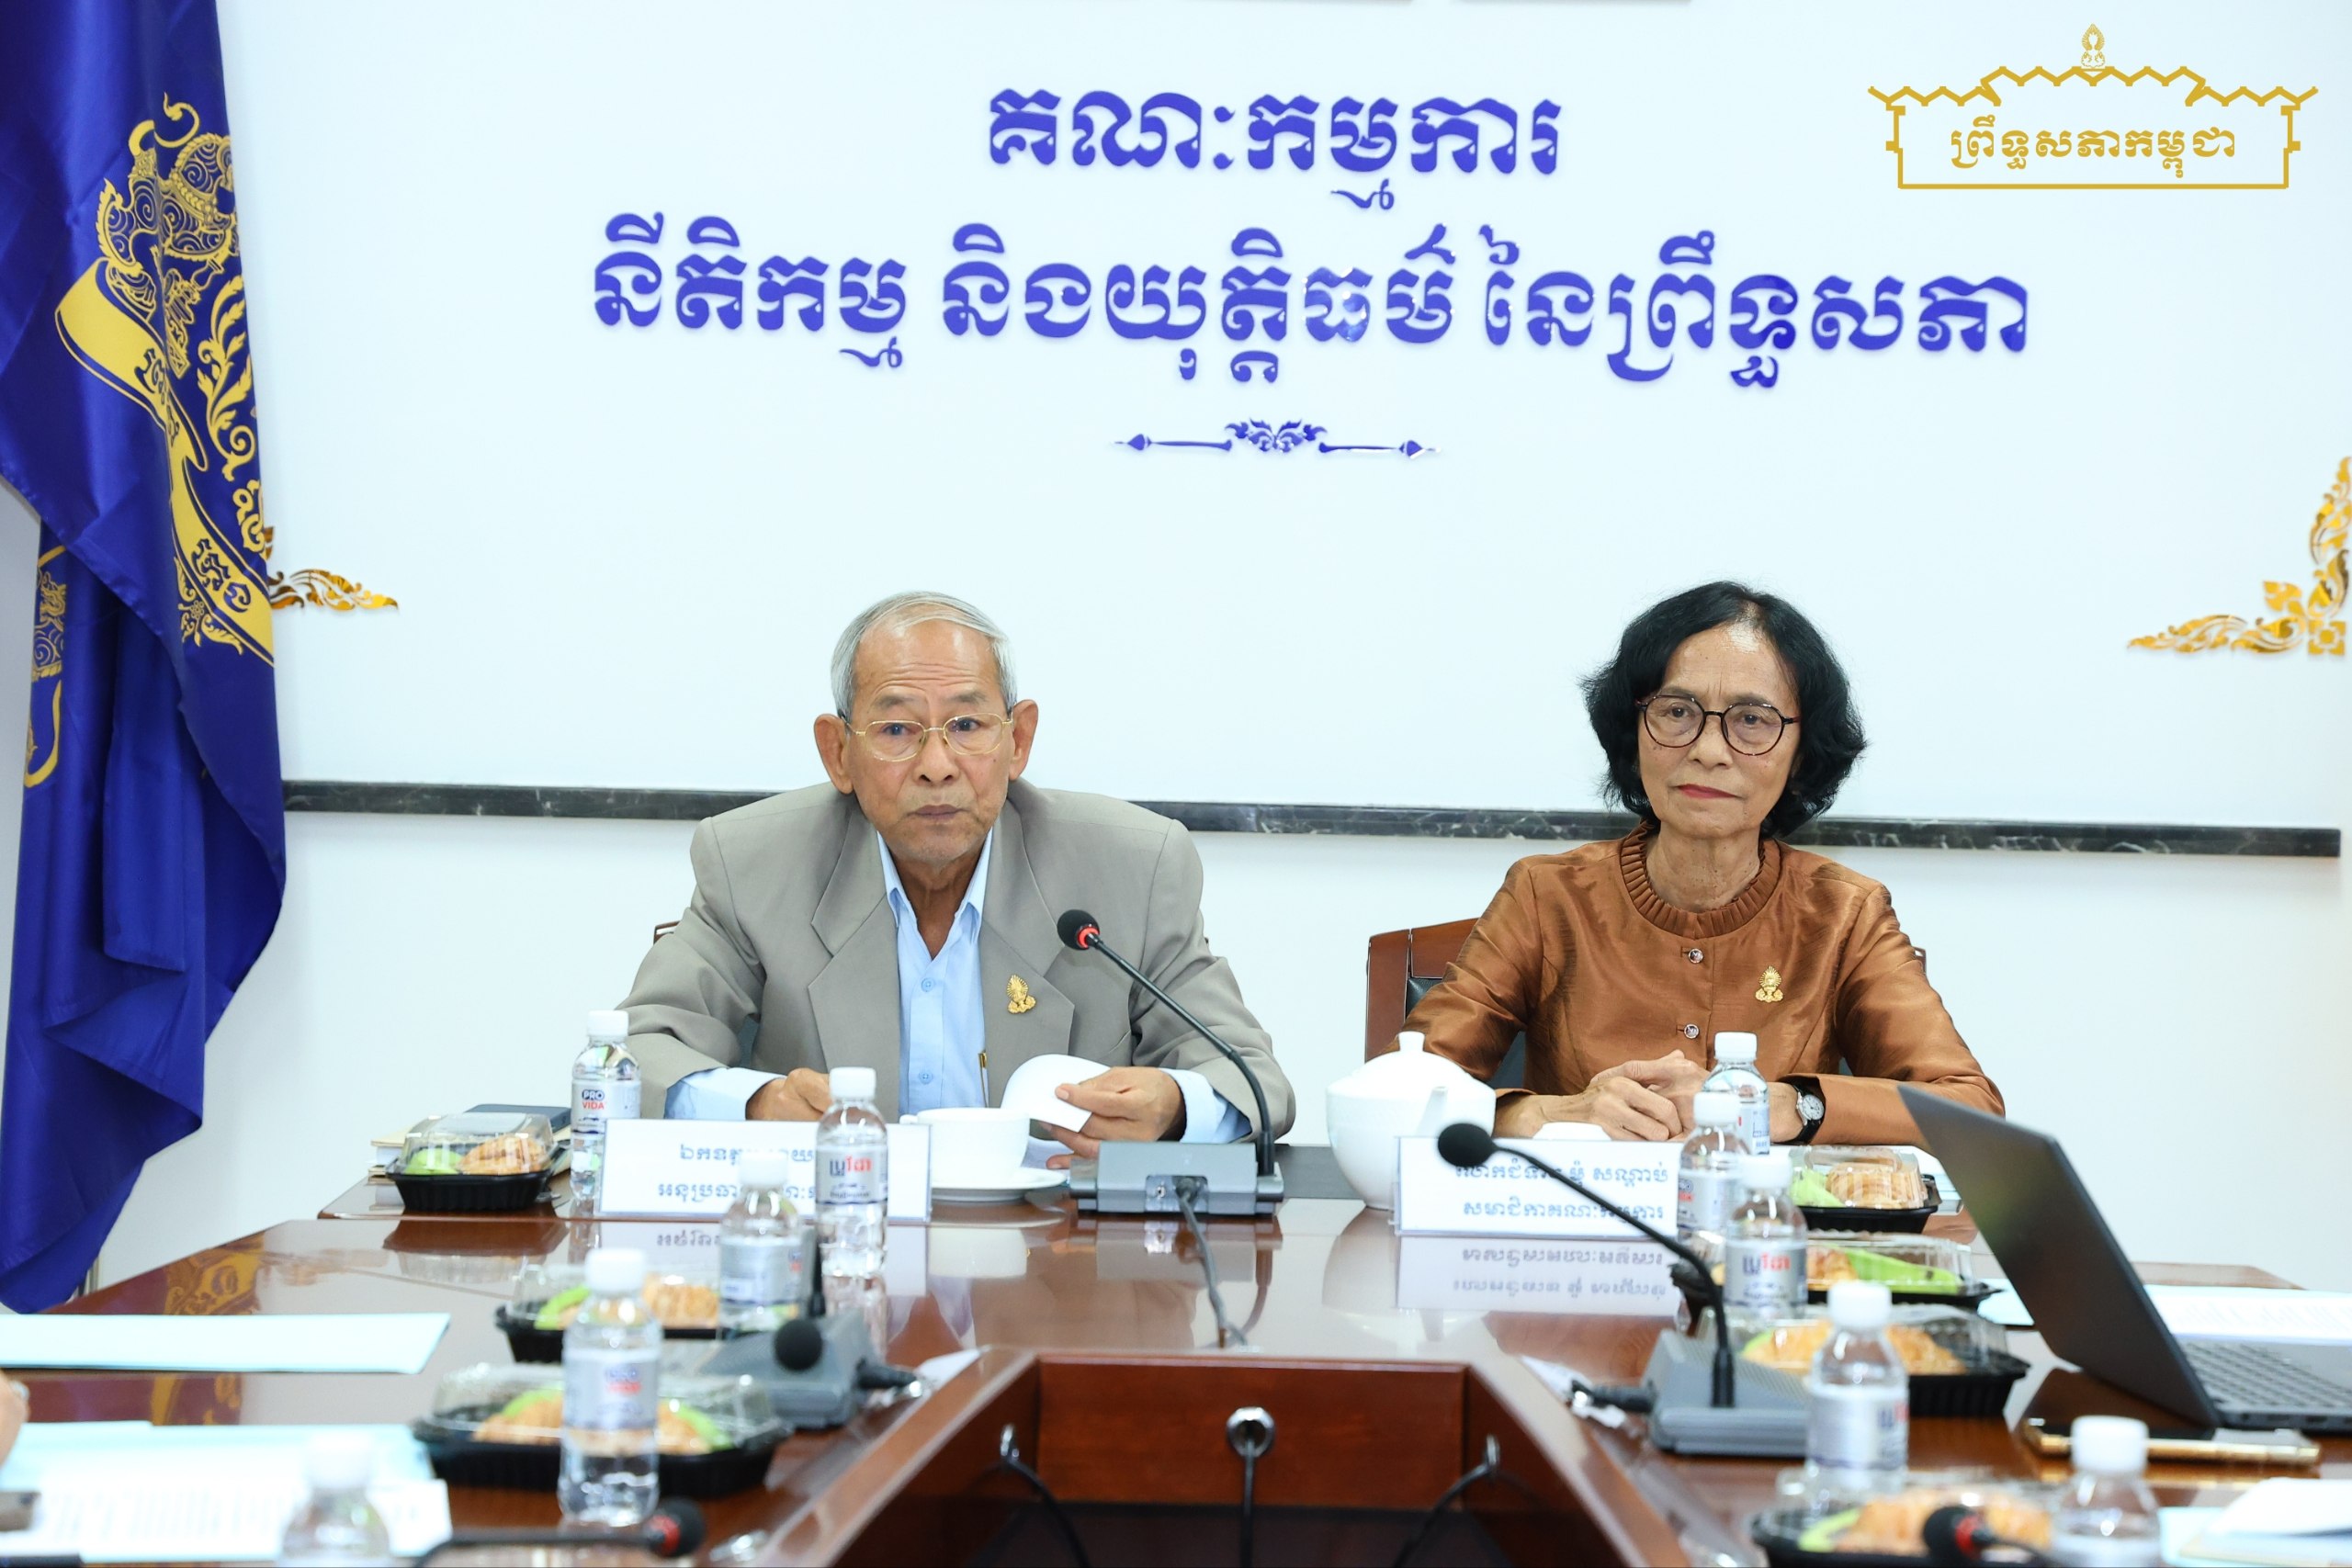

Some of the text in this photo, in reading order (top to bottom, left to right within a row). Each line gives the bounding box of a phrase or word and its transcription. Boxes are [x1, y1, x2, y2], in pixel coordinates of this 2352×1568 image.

[989, 87, 1563, 211] គណៈកម្មការ
[594, 211, 2029, 389] នីតិកម្ម និងយុត្តិធម៌ នៃព្រឹទ្ធសភា
[582, 1089, 605, 1101] PRO
[582, 1101, 605, 1111] VIDA
